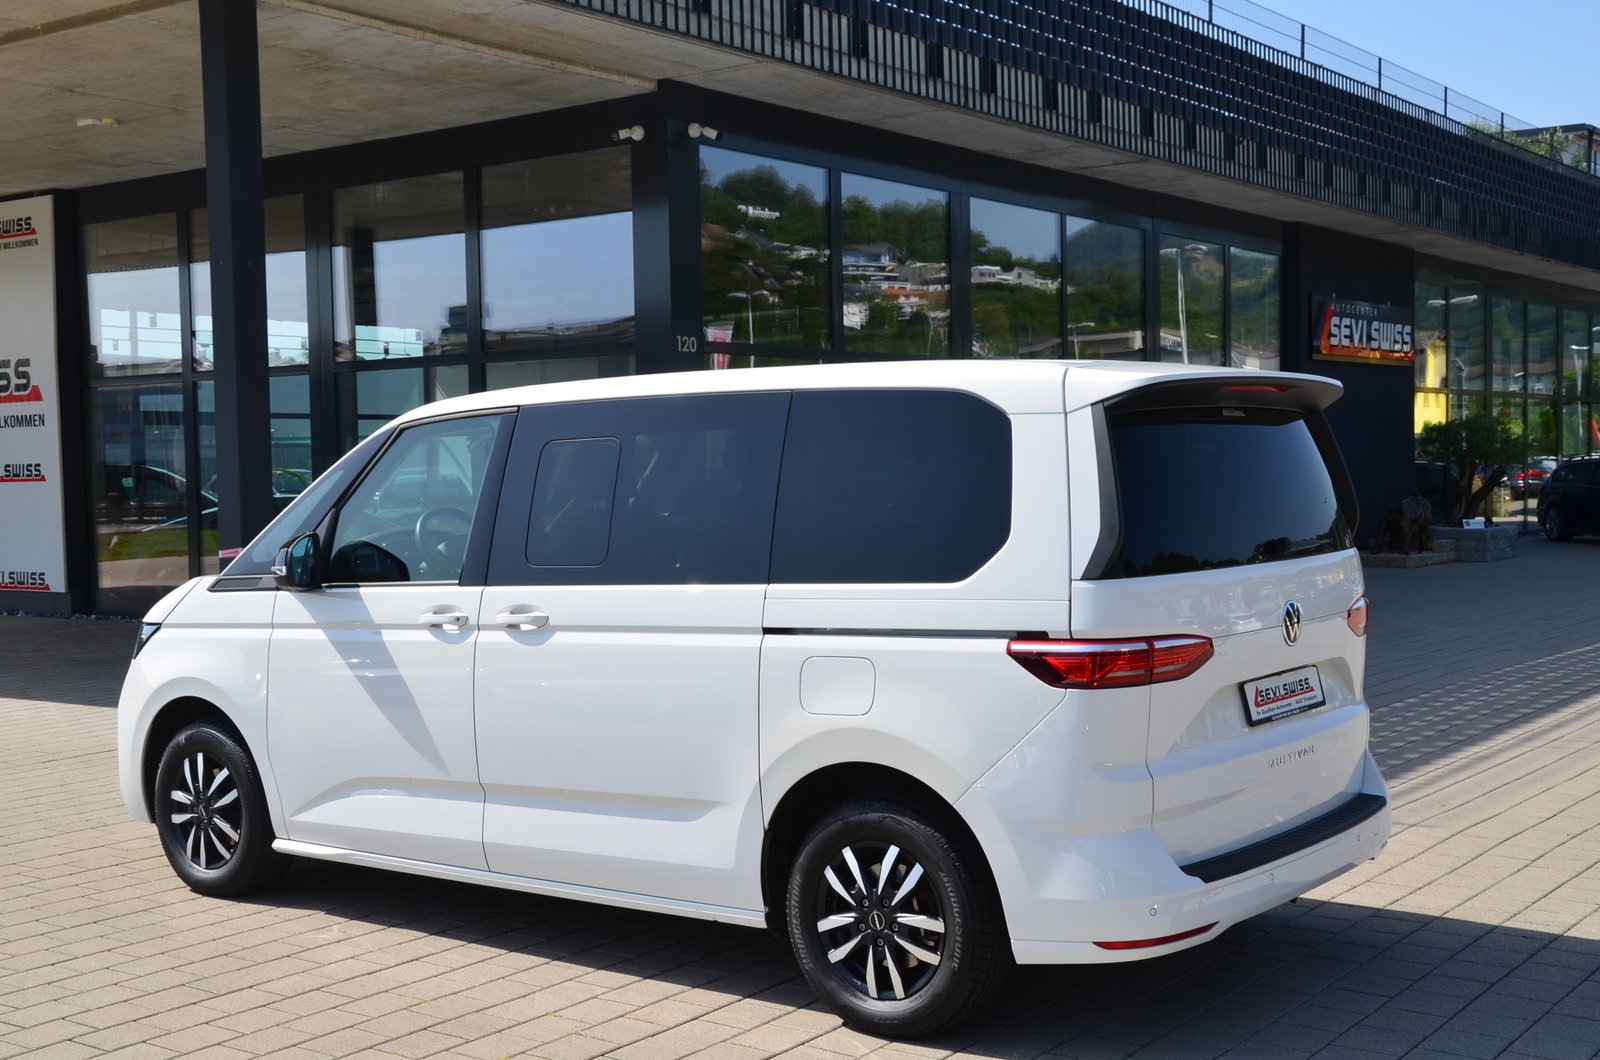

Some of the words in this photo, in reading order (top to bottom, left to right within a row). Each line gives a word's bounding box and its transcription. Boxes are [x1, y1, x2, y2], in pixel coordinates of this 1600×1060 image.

[0, 216, 32, 235] WISS
[1331, 303, 1378, 317] AUTOCENTER
[676, 335, 697, 352] 120
[1329, 316, 1367, 349] SEVI
[1370, 320, 1412, 353] SWISS
[4, 463, 42, 478] SWISS
[8, 571, 46, 586] SWISS
[1259, 685, 1281, 703] SEVI
[1282, 677, 1311, 697] SWISS
[1267, 744, 1315, 769] MULTIVAN
